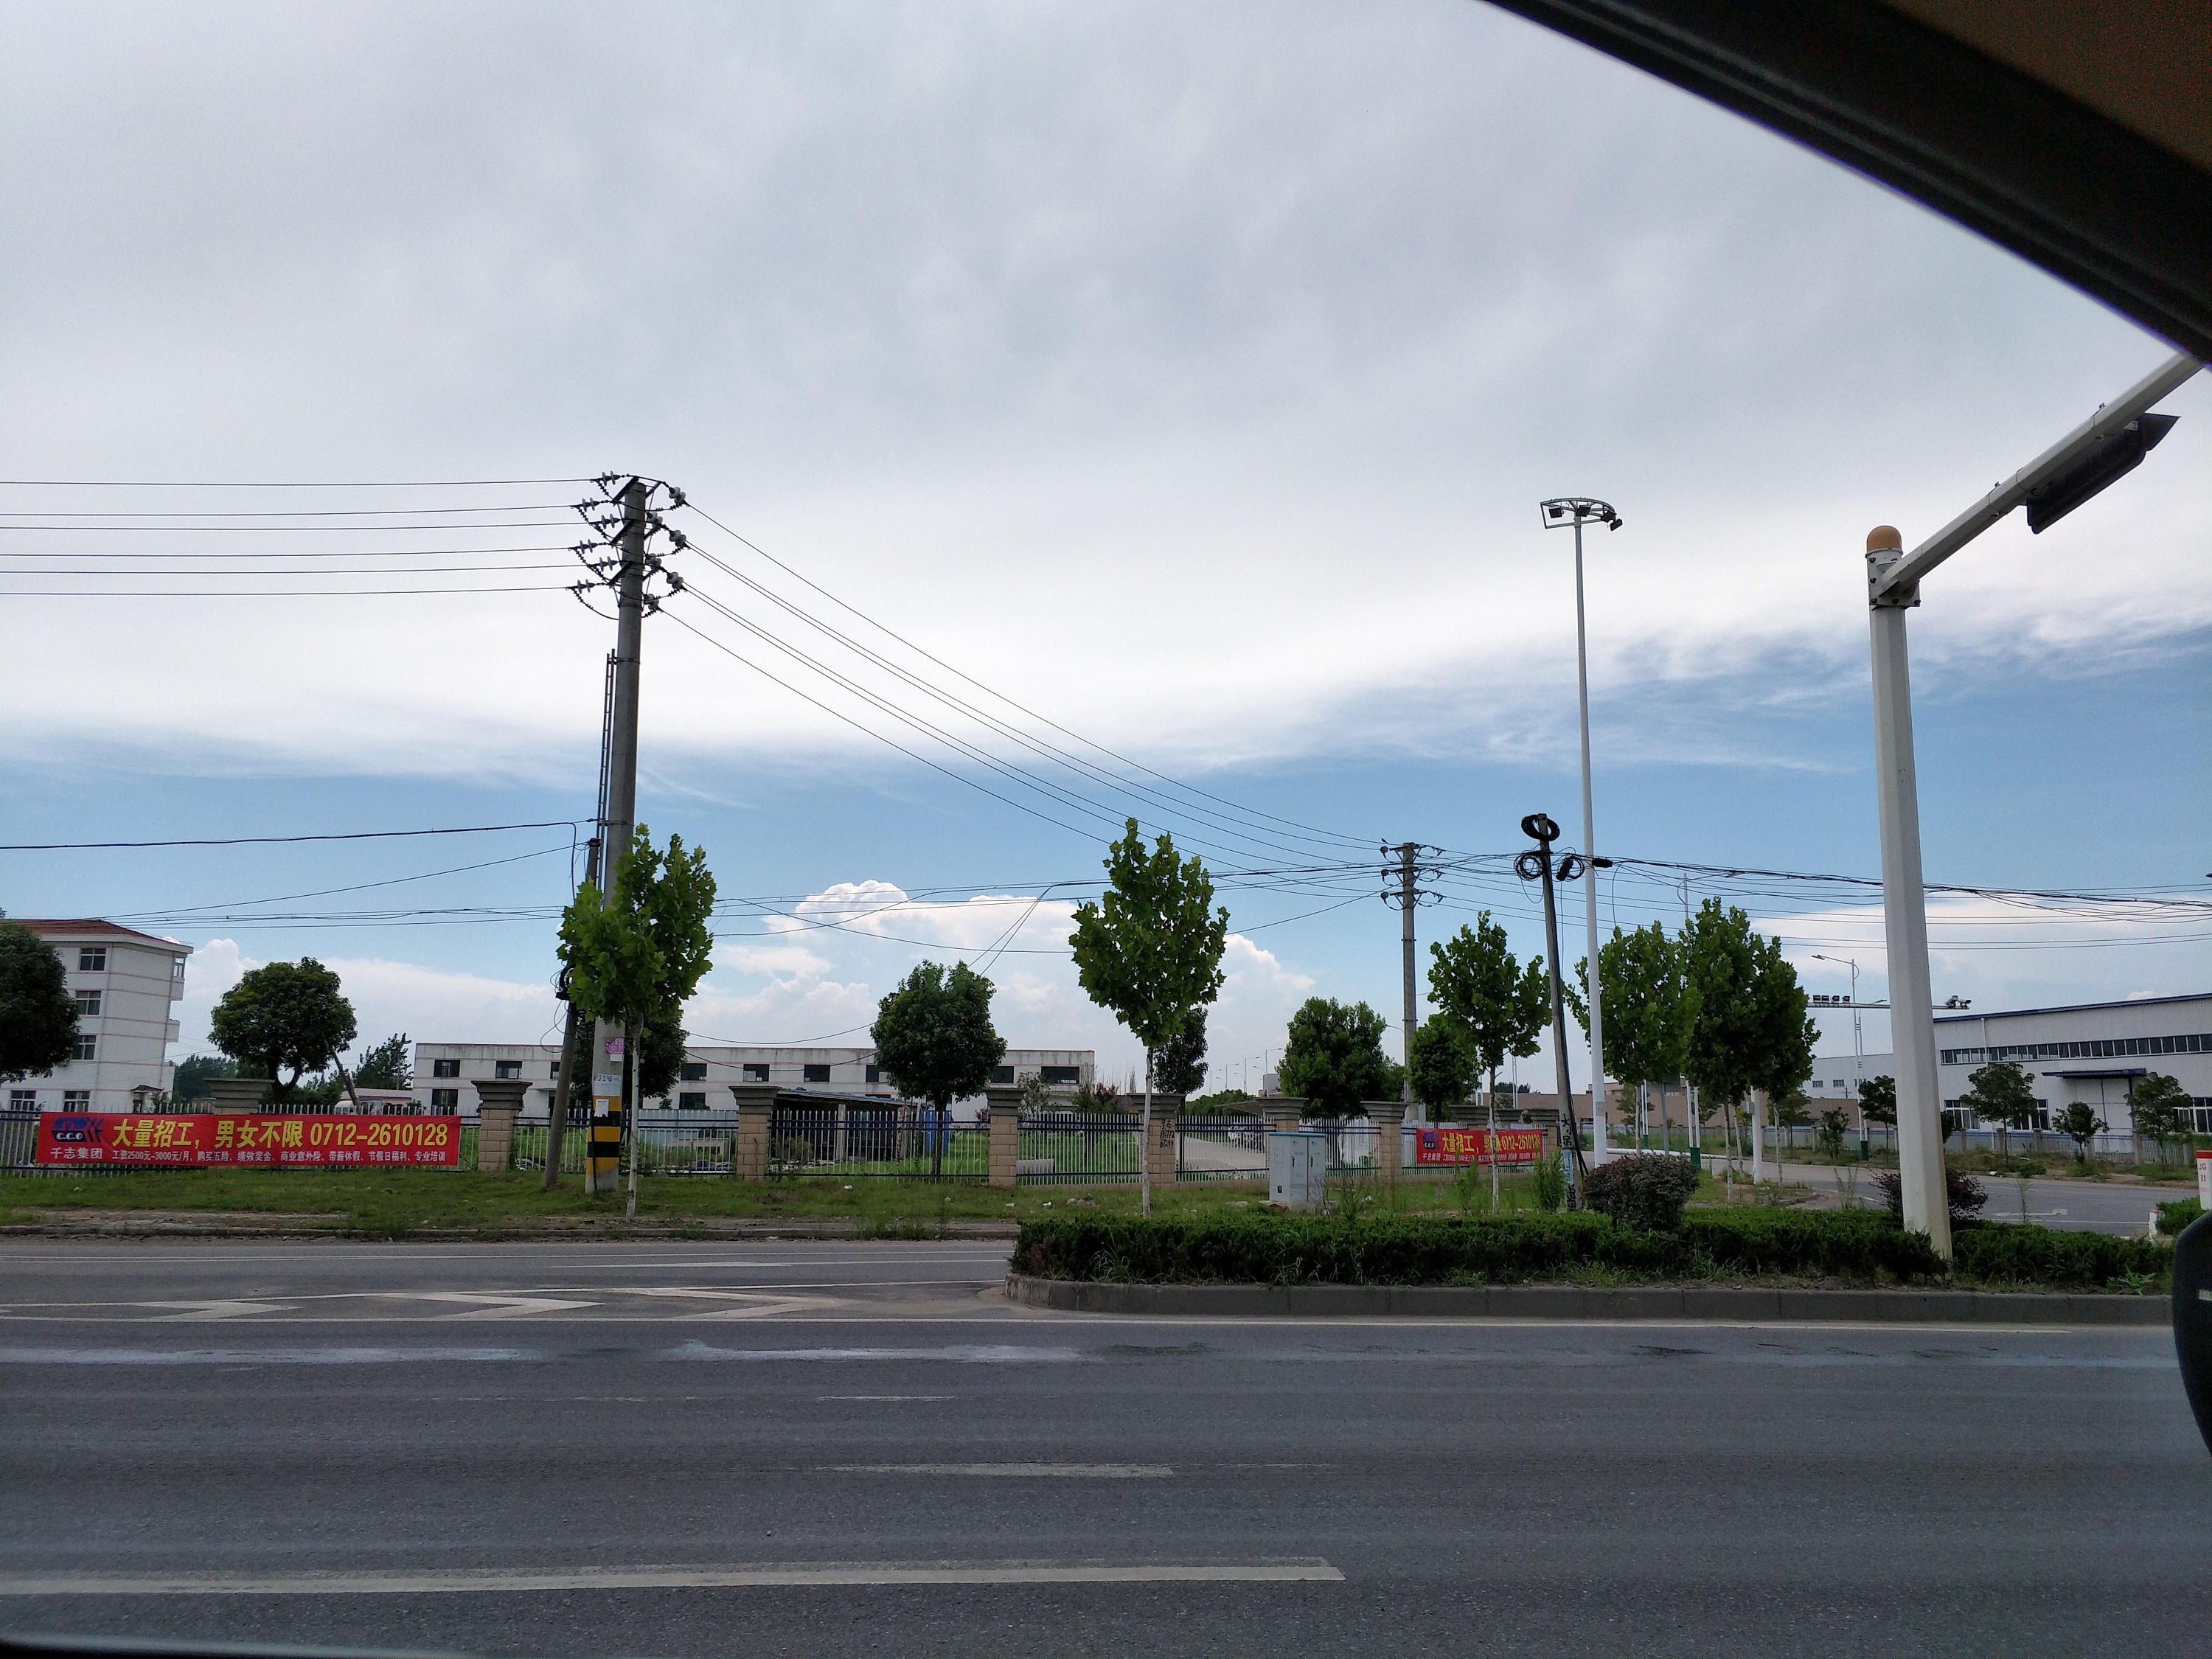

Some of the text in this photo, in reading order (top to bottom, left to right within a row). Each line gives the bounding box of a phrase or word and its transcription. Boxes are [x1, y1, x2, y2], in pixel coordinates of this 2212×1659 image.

[310, 1123, 448, 1146] 0712-2610128
[50, 1147, 103, 1160] 千志集团
